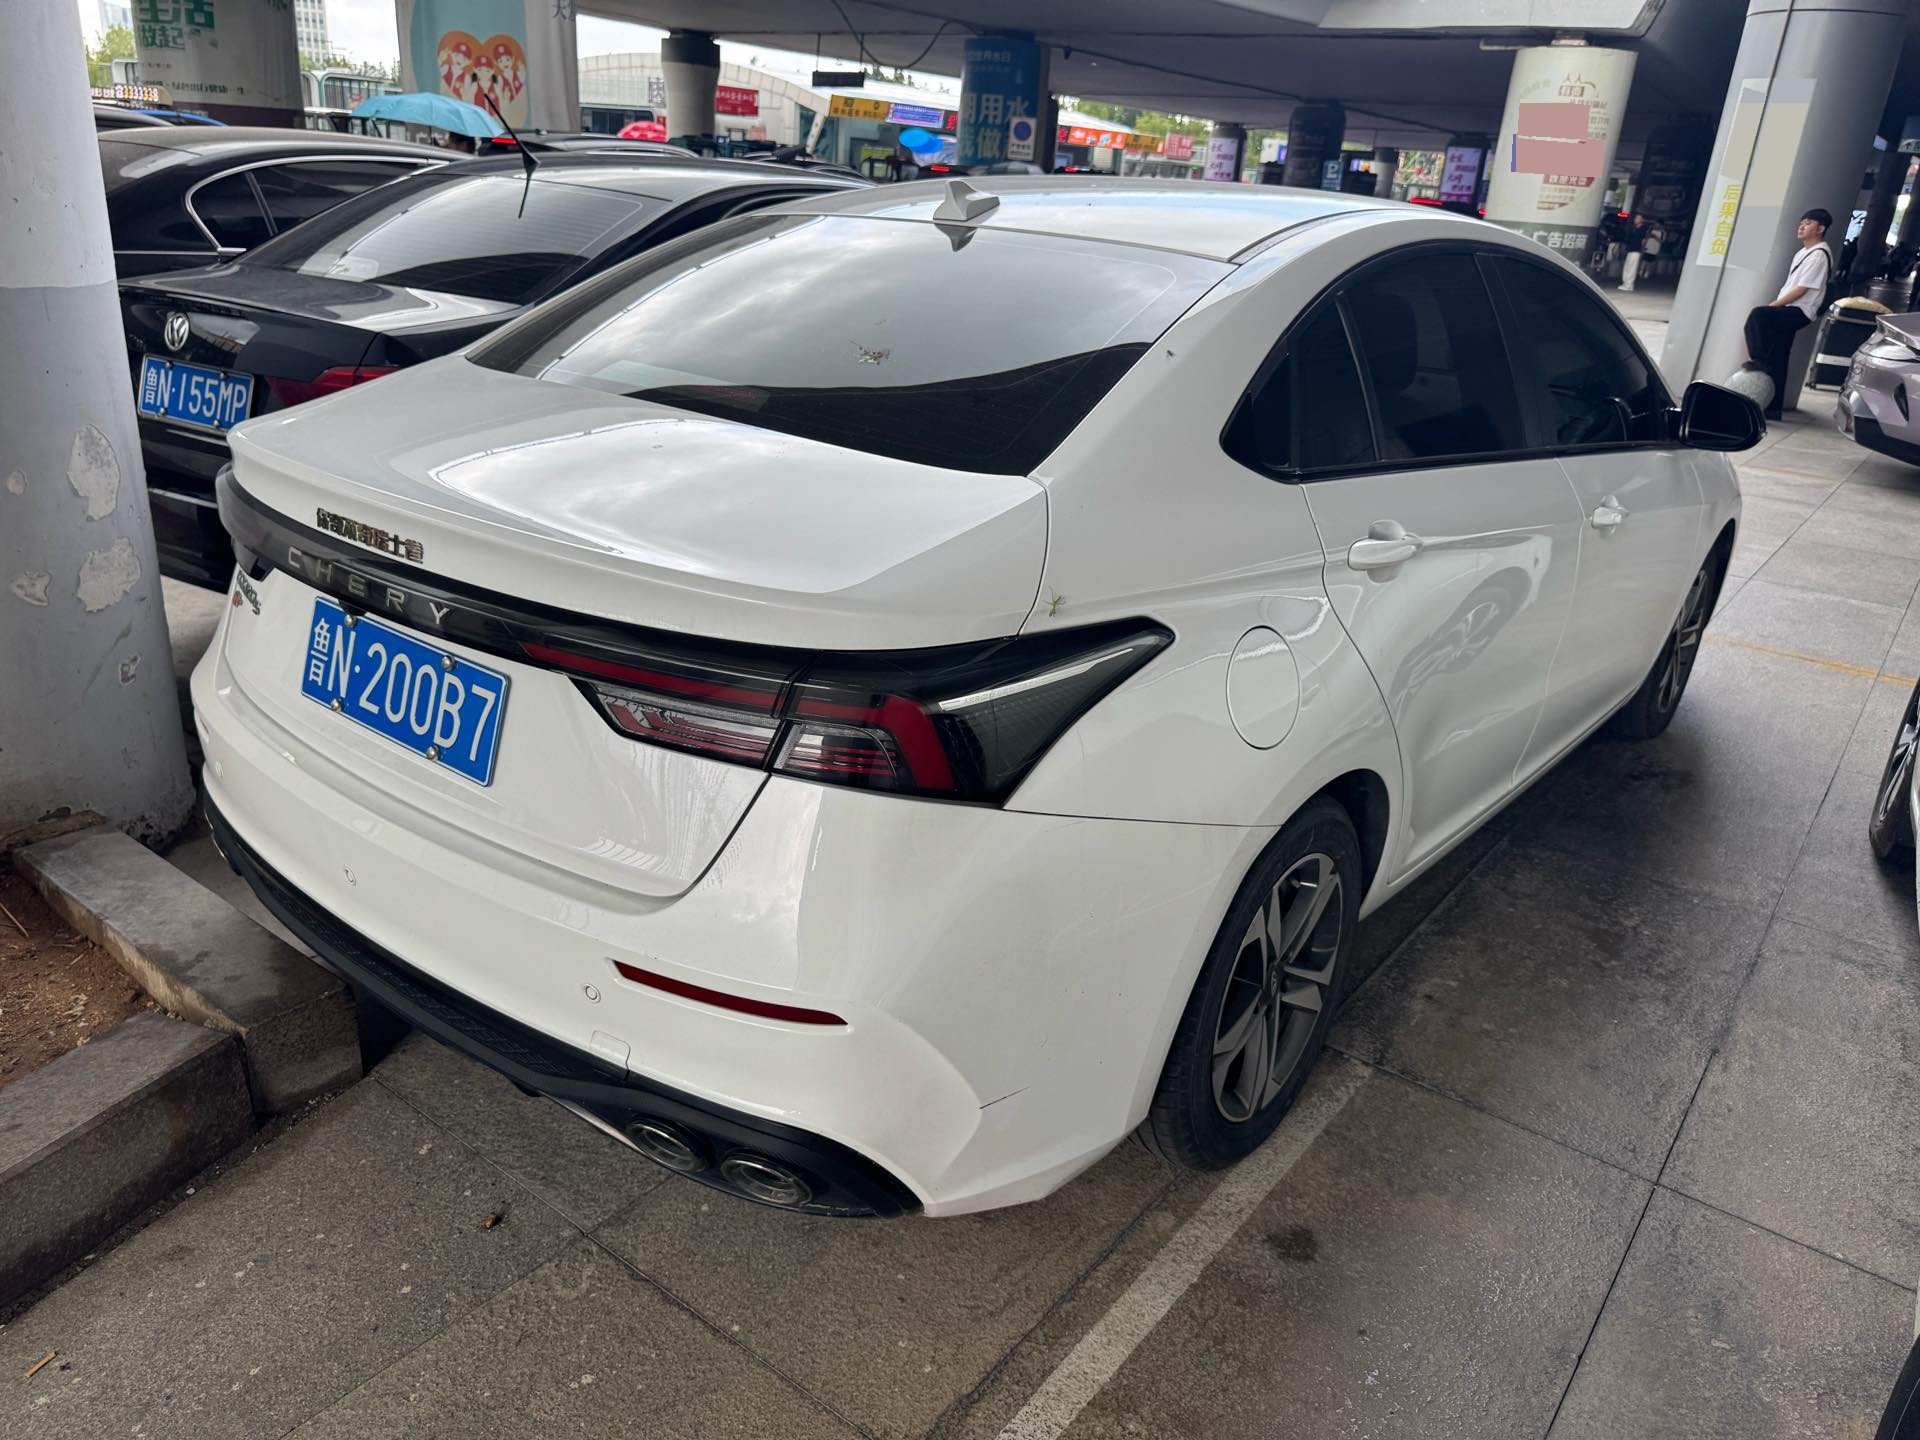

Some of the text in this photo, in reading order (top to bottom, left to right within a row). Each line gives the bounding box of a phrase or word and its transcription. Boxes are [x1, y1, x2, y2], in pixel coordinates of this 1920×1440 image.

[1707, 183, 1742, 256] 后果自负
[144, 366, 247, 423] 鲁N·155MP
[288, 546, 450, 625] CHERY
[308, 617, 497, 762] 鲁N·200B7
